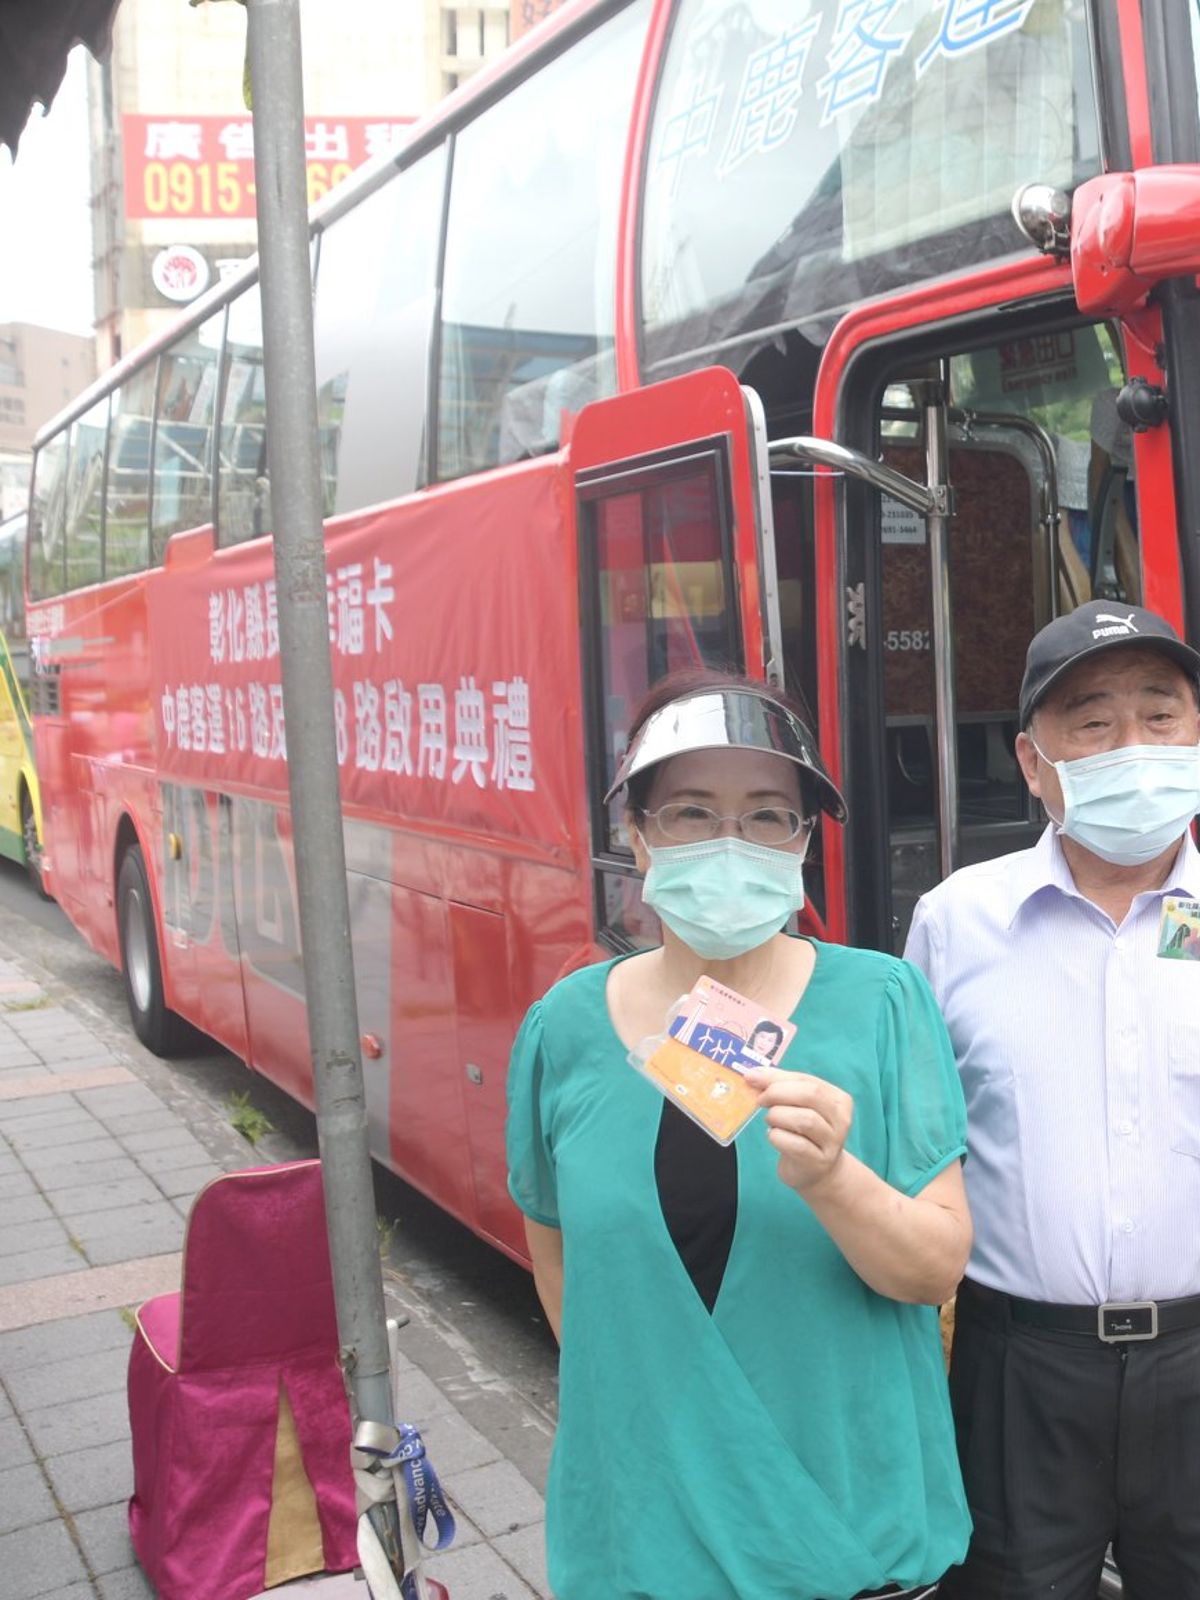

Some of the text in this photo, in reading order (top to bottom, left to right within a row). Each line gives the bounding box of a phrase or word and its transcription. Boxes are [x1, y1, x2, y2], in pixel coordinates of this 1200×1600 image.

[208, 556, 395, 664] 彰化縣長福卡
[1092, 625, 1130, 639] PUMA
